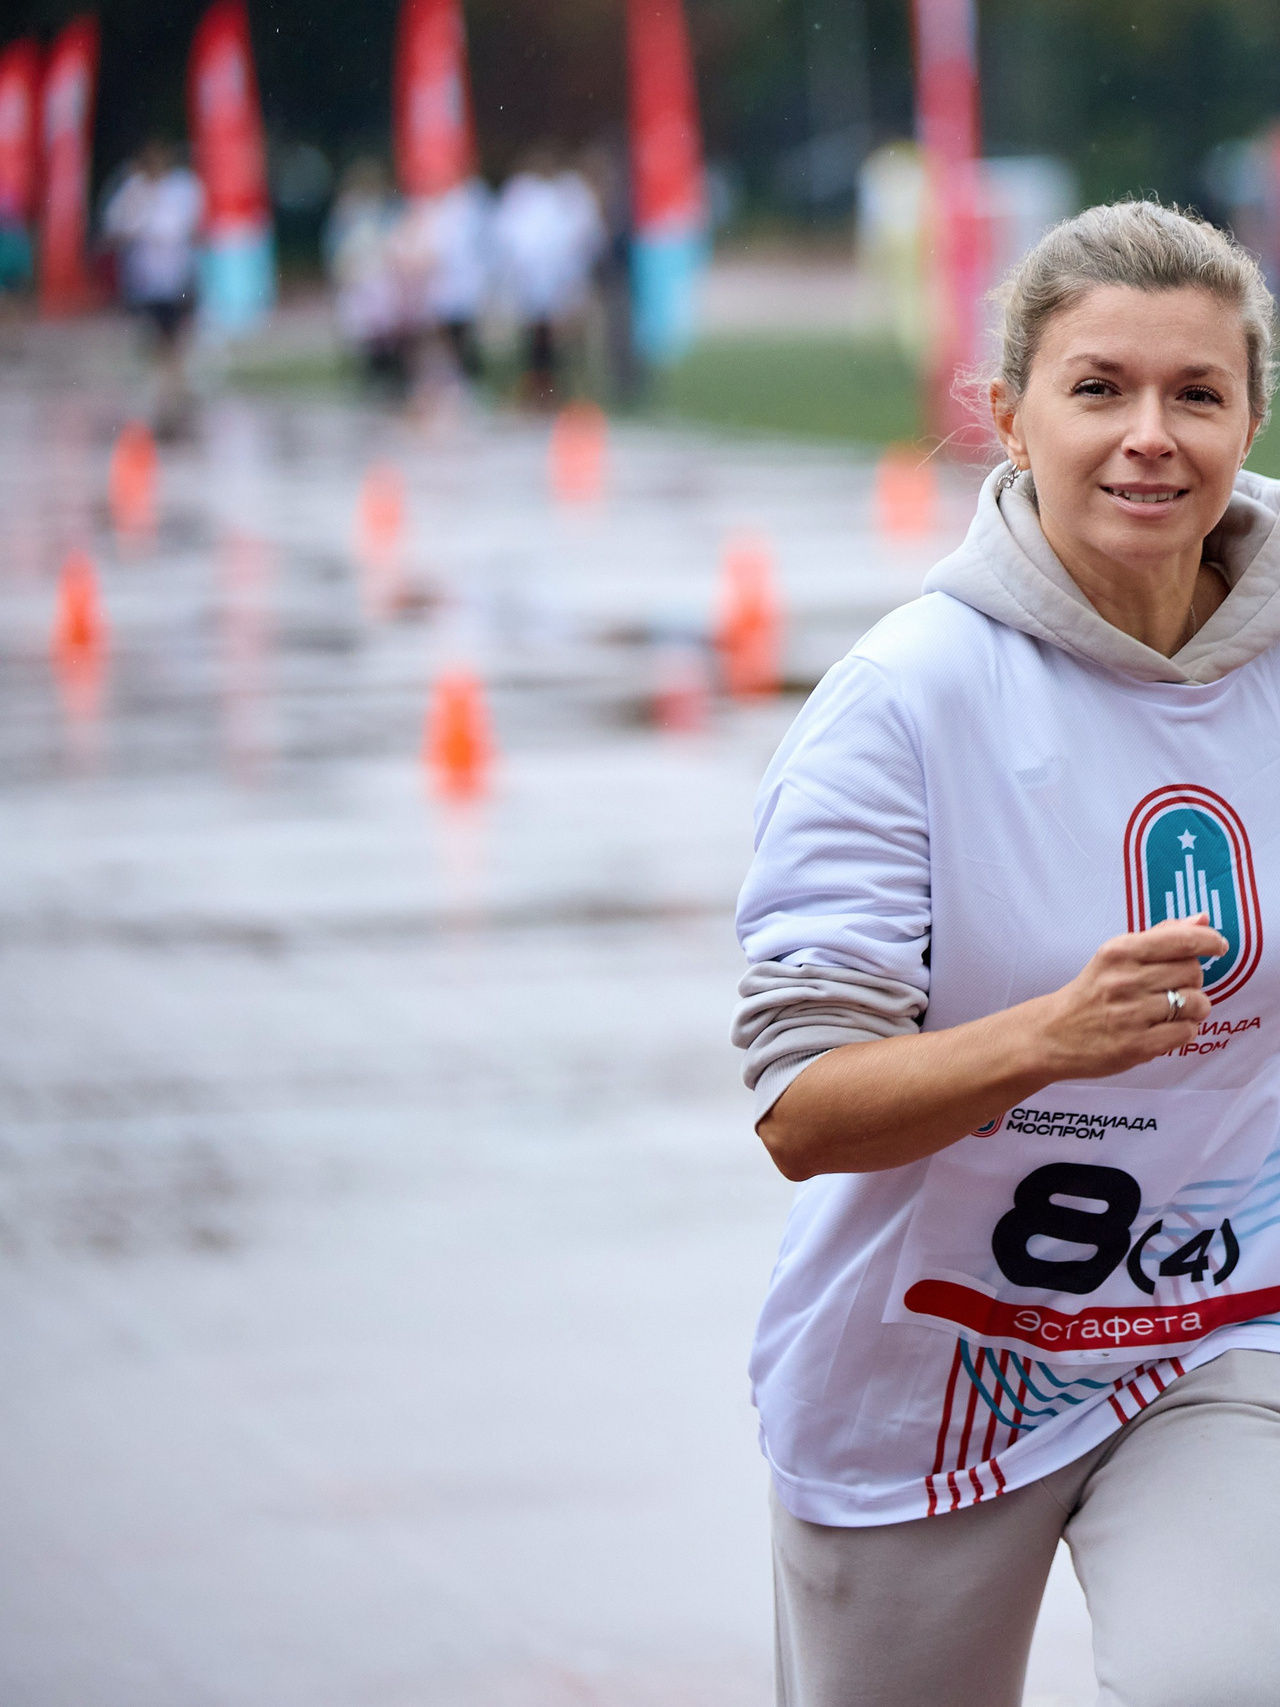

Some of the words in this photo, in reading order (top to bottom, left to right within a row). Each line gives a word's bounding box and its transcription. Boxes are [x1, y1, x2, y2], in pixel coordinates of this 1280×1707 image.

[1006, 1120, 1105, 1140] МОСПРОМ
[1011, 1107, 1158, 1131] СПАРТАКИАДА
[1013, 1310, 1203, 1344] Эстафета
